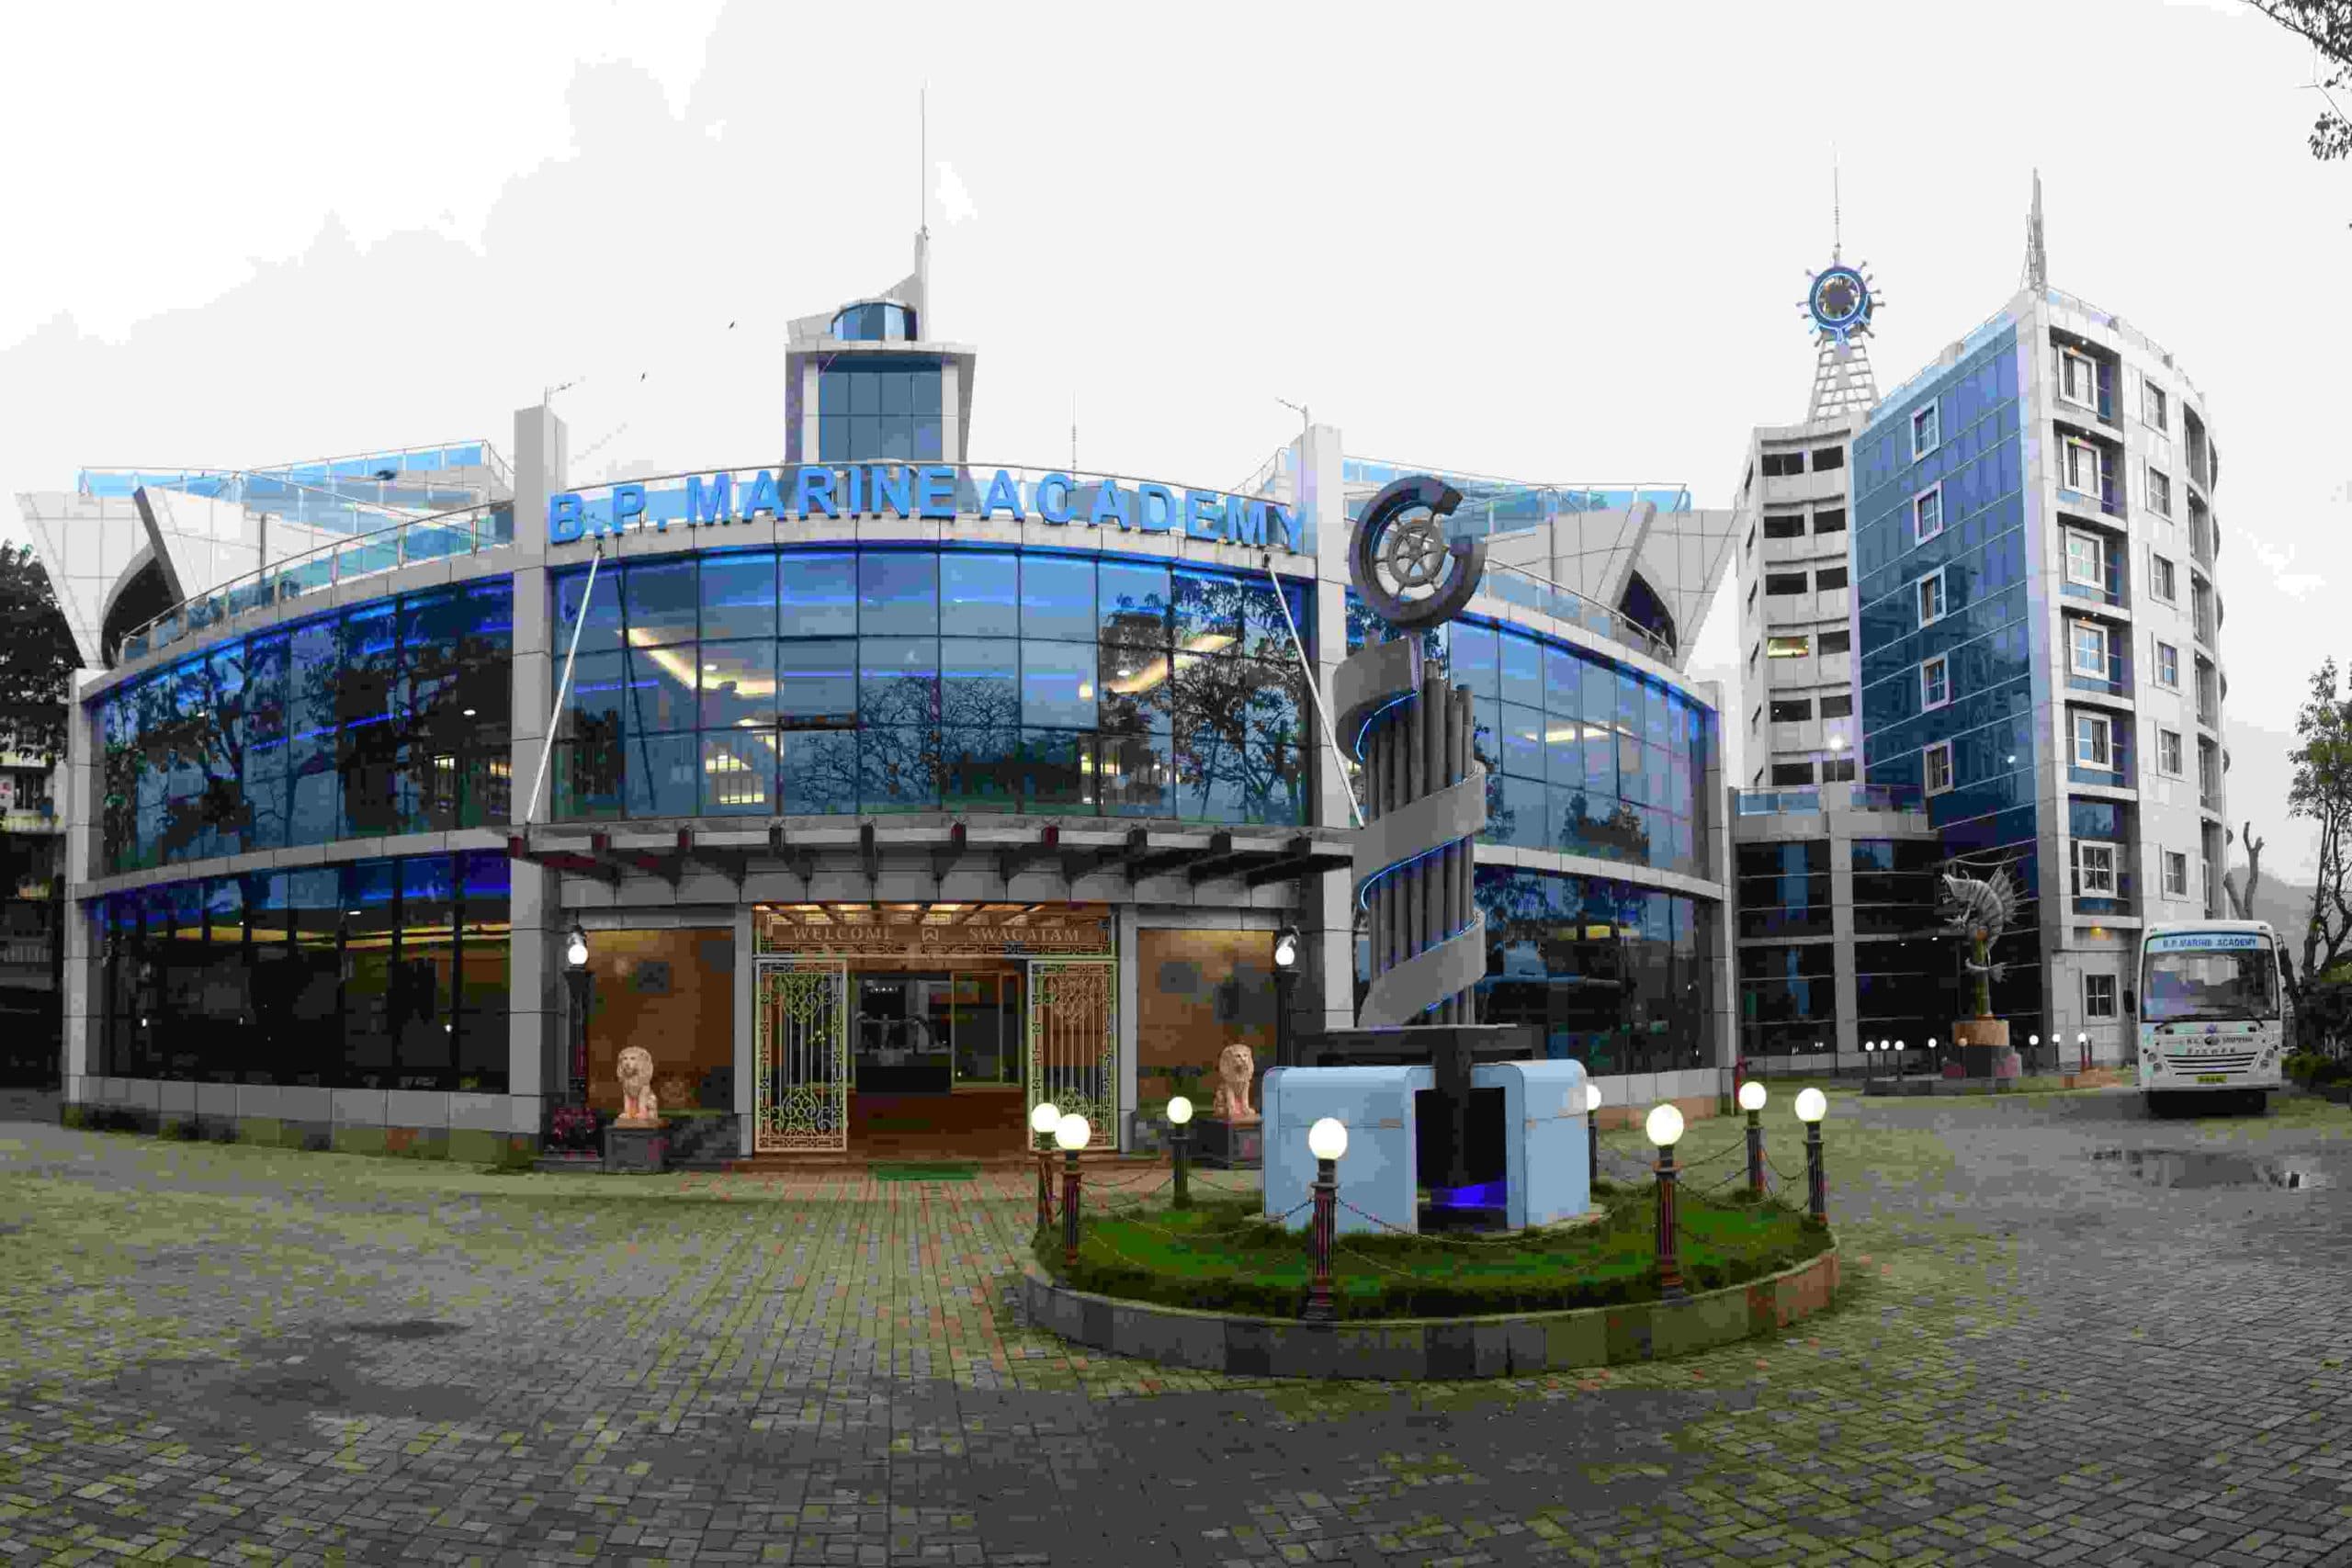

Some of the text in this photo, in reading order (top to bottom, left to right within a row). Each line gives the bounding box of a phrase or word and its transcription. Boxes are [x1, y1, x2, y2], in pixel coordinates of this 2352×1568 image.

[548, 464, 1307, 555] B.P. MARINE ACADEMY
[793, 926, 1080, 942] WELCOME SWAGATAM
